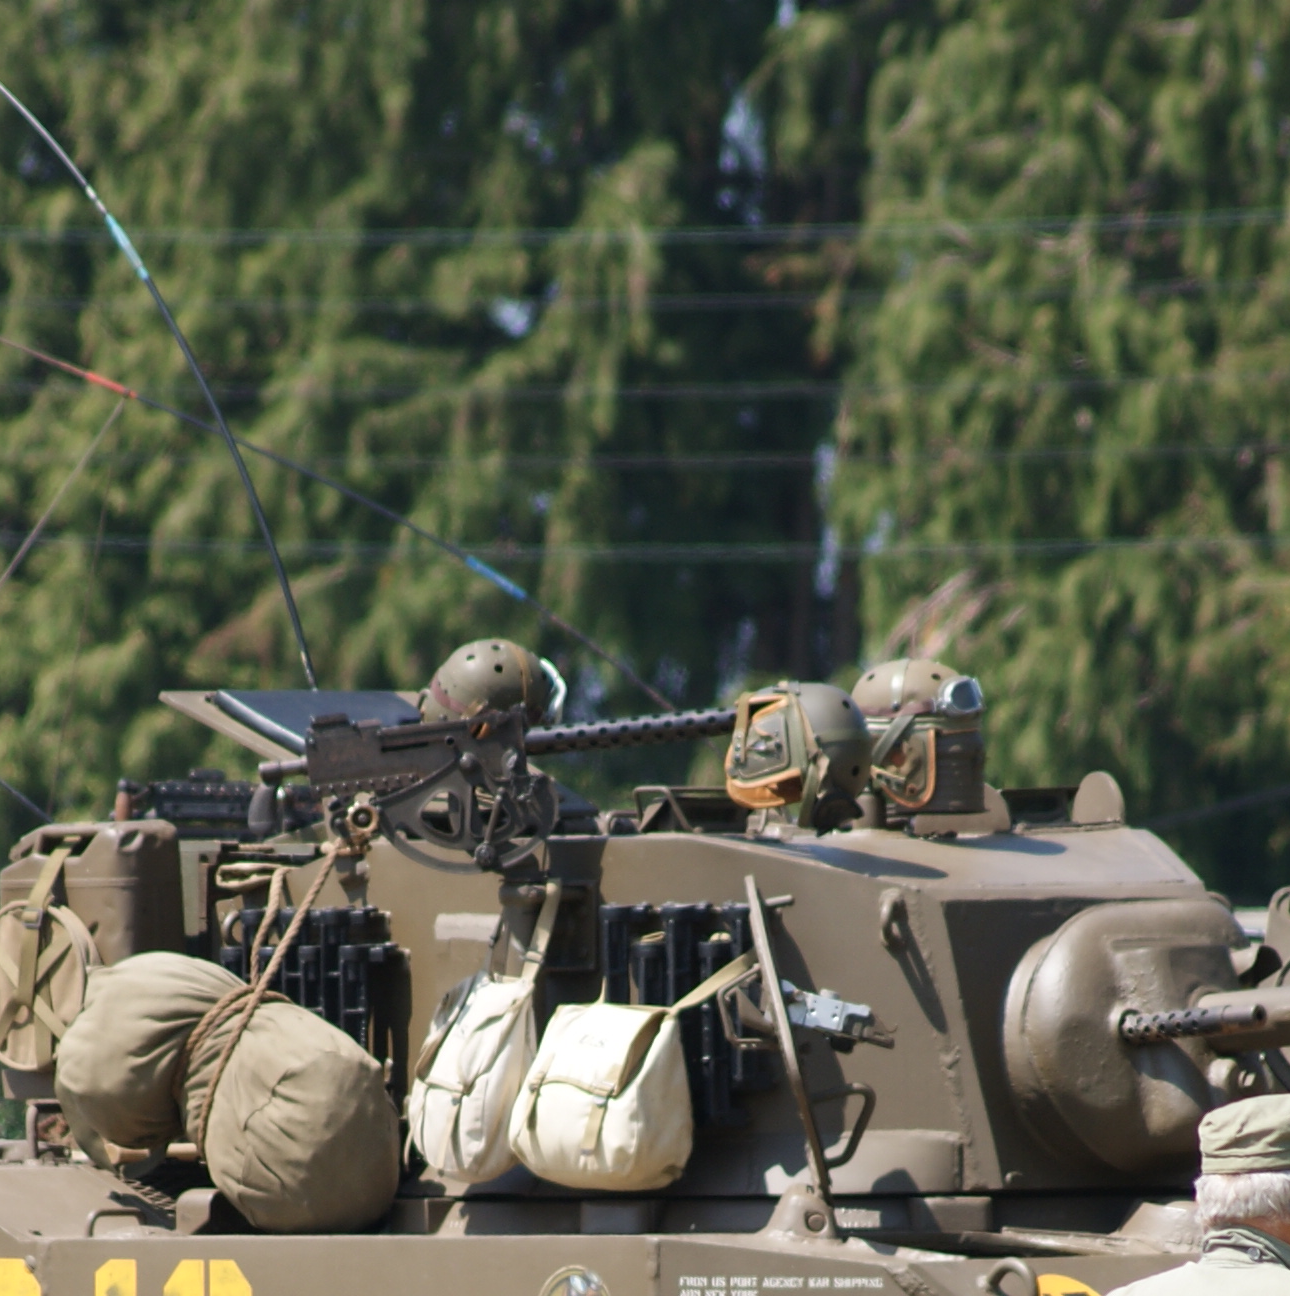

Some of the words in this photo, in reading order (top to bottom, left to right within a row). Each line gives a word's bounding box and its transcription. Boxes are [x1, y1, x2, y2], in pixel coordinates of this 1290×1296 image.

[711, 1276, 727, 1288] US
[729, 1276, 758, 1288] PORT
[762, 1276, 804, 1289] AGENCY
[833, 1277, 884, 1289] SHIPPING
